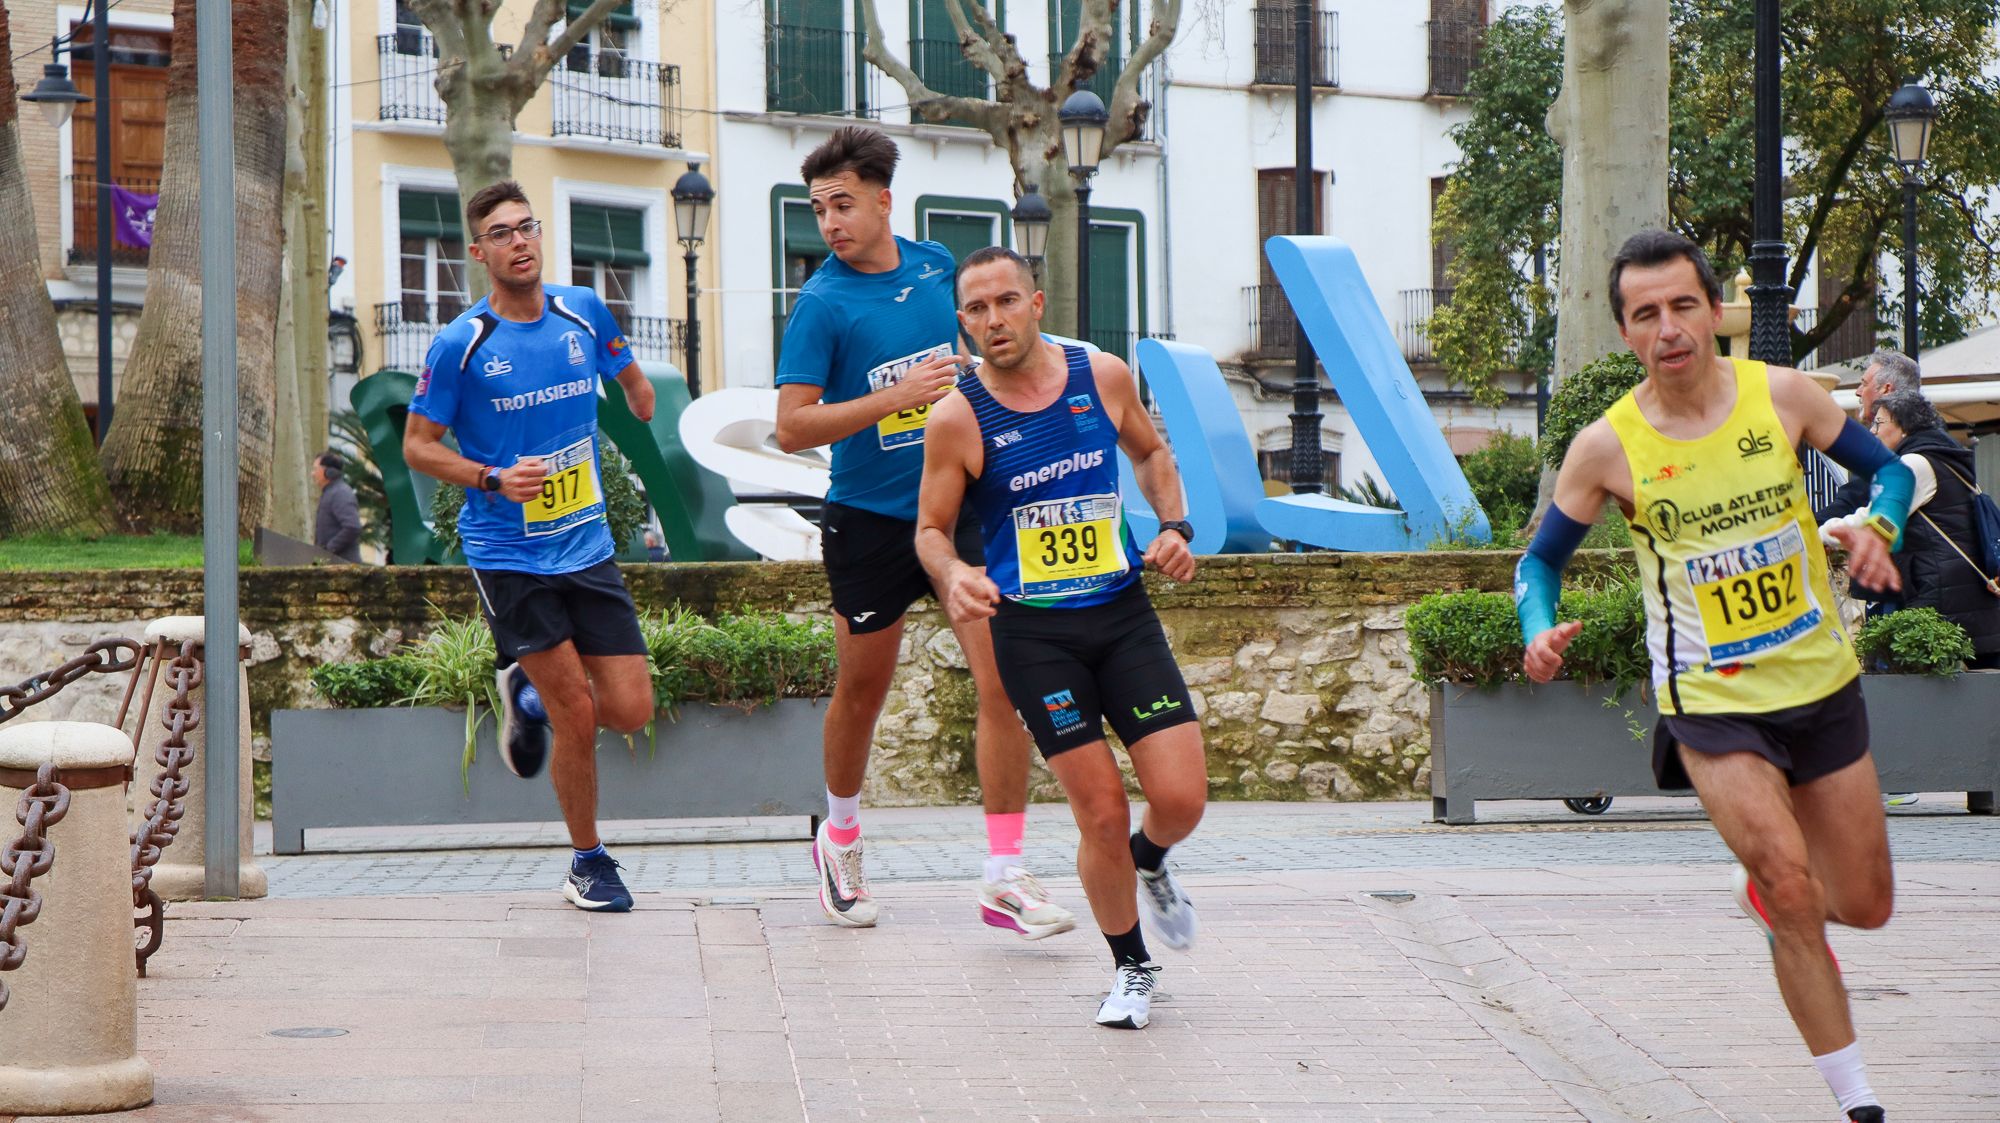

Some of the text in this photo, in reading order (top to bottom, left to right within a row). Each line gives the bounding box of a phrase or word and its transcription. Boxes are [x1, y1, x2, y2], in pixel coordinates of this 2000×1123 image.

[491, 377, 593, 412] TROTASIERRA
[542, 469, 579, 509] 917
[1010, 449, 1104, 491] enerplus
[1029, 504, 1064, 528] 21K
[1682, 503, 1724, 524] CLUB
[1701, 497, 1792, 536] MONTILLA
[1040, 525, 1098, 566] 339
[1701, 548, 1745, 582] 21K
[1711, 562, 1797, 625] 1362
